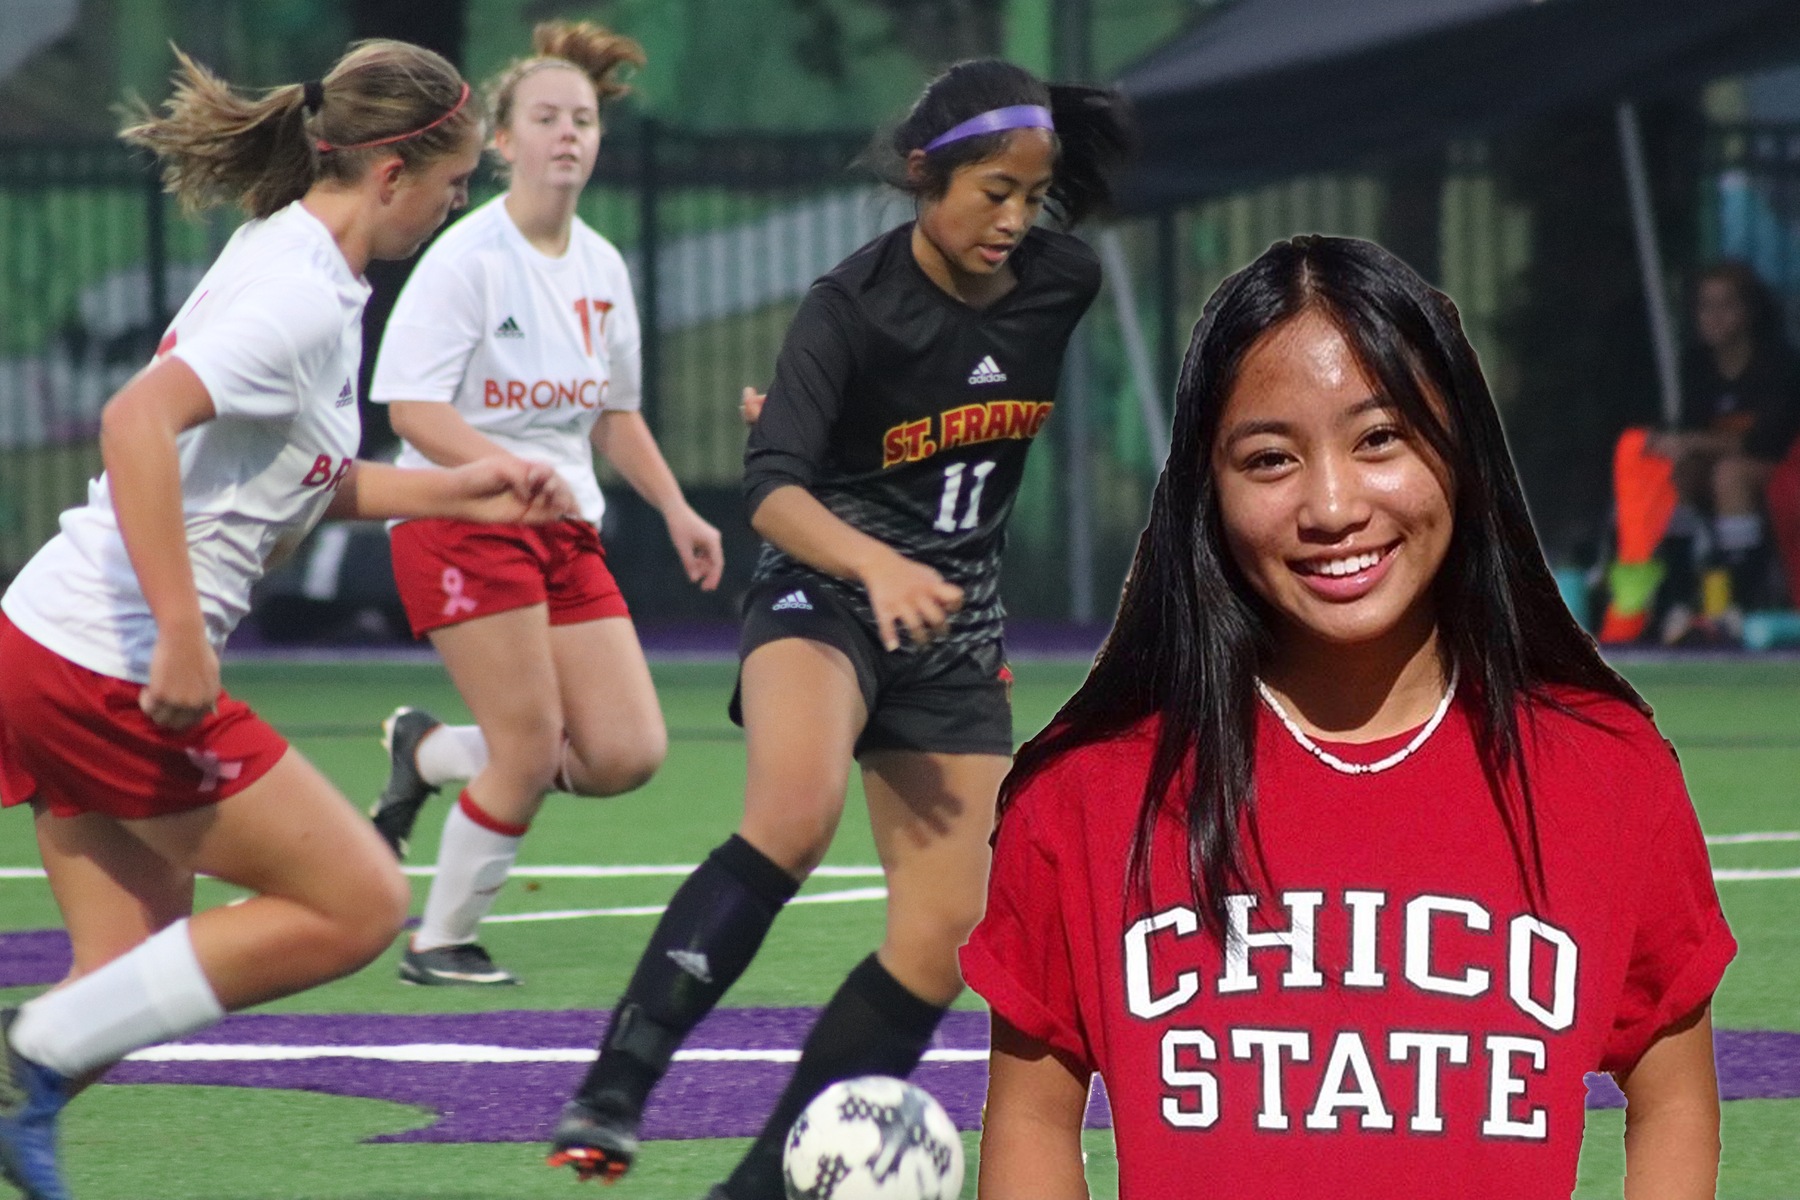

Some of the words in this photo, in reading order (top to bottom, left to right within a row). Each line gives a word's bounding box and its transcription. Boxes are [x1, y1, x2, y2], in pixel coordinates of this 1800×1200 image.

[573, 297, 614, 358] 17
[968, 373, 1007, 385] adidas
[882, 417, 937, 469] ST.
[933, 460, 996, 533] 11
[772, 602, 813, 611] adidas
[1123, 889, 1579, 1031] CHICO
[1160, 1028, 1547, 1139] STATE
